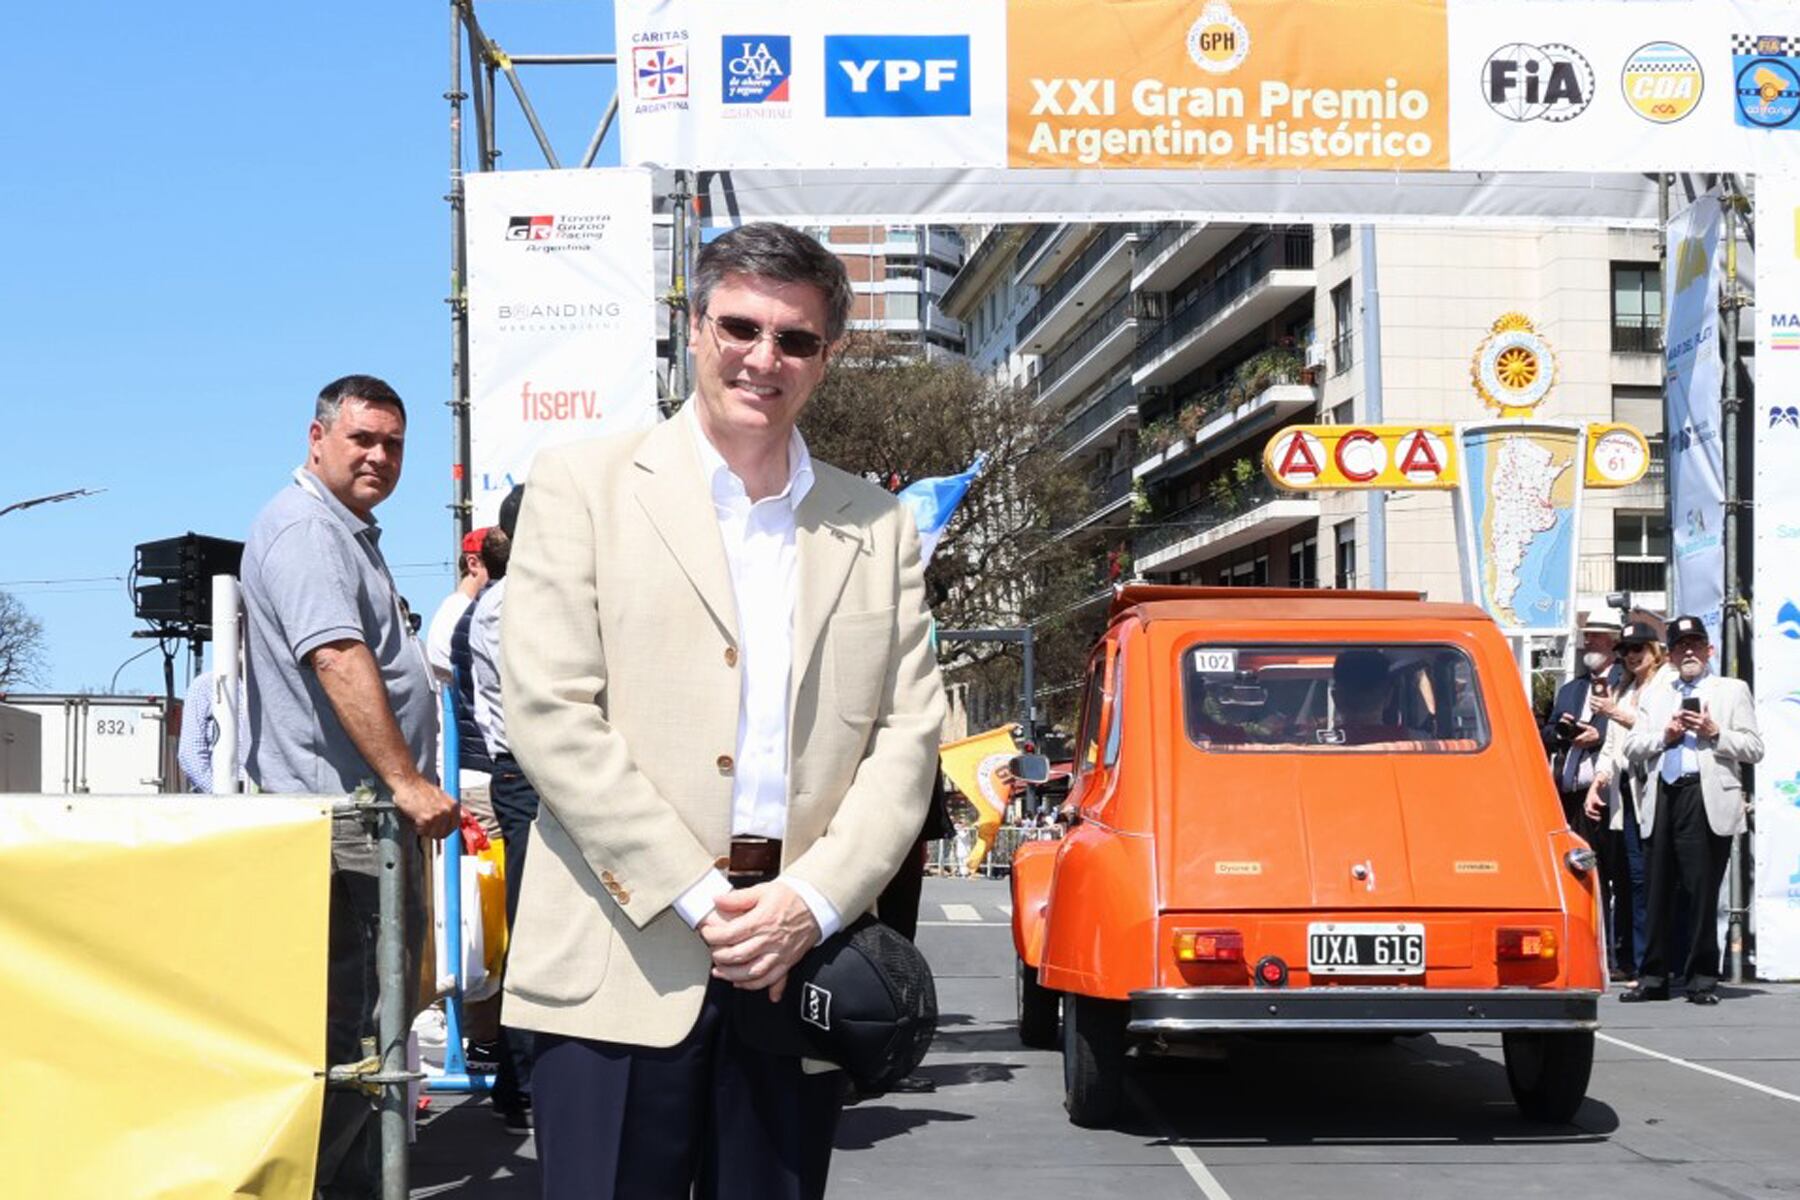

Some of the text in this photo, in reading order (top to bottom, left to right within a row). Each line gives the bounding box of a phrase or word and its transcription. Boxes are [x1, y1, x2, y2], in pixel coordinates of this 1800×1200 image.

[742, 43, 772, 59] LA
[1200, 32, 1235, 51] GPH
[728, 58, 783, 80] CAJA
[838, 60, 959, 92] YPF
[1632, 76, 1693, 99] CDA
[635, 101, 689, 115] ARGENTINA
[1029, 78, 1430, 120] XXI Gran Premio
[1028, 120, 1431, 164] Argentino Histórico
[1278, 429, 1442, 482] ACA
[1608, 456, 1625, 471] 61
[1198, 653, 1230, 671] 102
[1312, 935, 1422, 966] UXA 616
